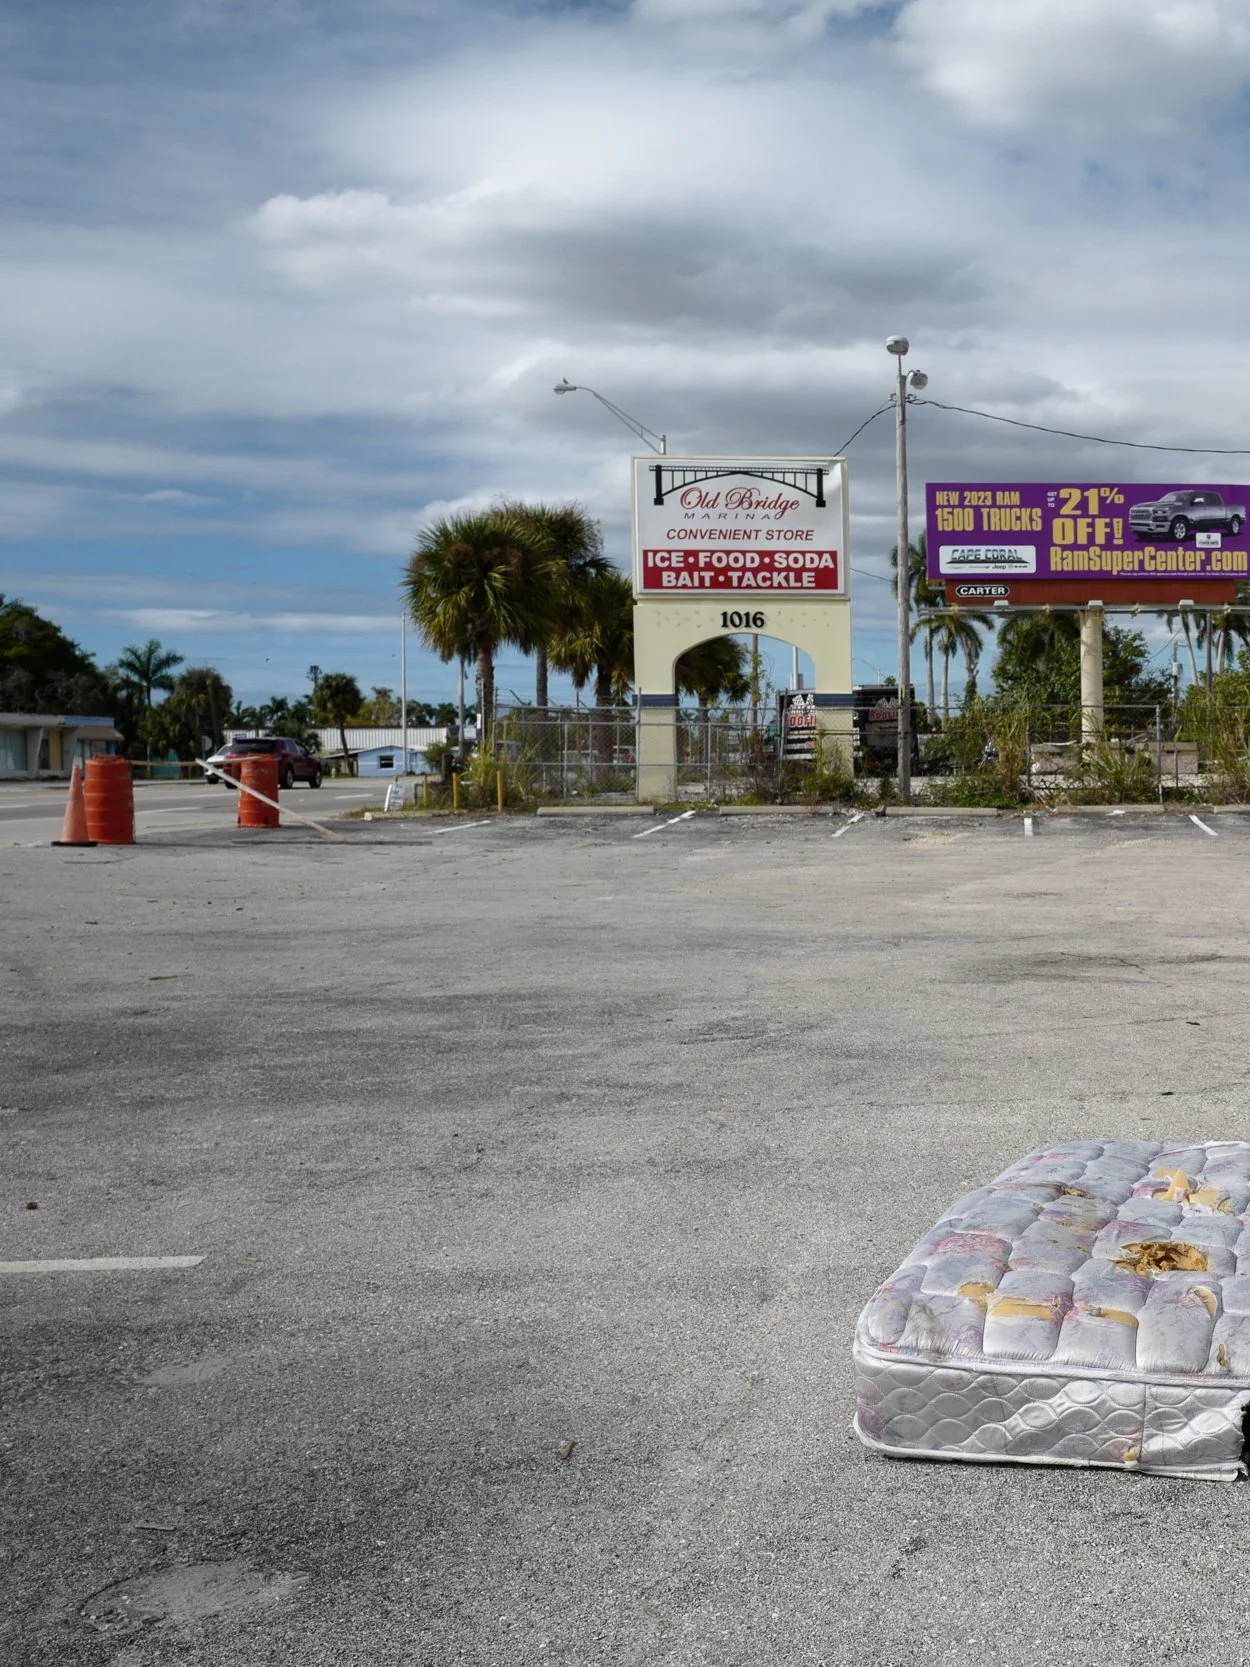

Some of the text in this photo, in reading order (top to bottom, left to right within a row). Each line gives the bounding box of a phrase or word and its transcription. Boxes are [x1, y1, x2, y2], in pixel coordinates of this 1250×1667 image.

[680, 486, 800, 520] Old Bridge
[935, 491, 1020, 506] NEW 2023 RAM
[1059, 487, 1125, 515] 21%
[684, 512, 772, 520] MARINA
[935, 508, 1042, 532] 1500 TRUCKS
[666, 528, 814, 541] CONVENIENT STORE
[1052, 518, 1124, 545] OFF!
[647, 552, 835, 569] ICE FOOD SODA
[951, 549, 1023, 561] CAPE CORAL
[1050, 546, 1248, 576] RamSuperCenter.com
[662, 571, 816, 587] BAIT TACKLE
[960, 587, 1005, 595] CARTER
[721, 611, 765, 628] 1016
